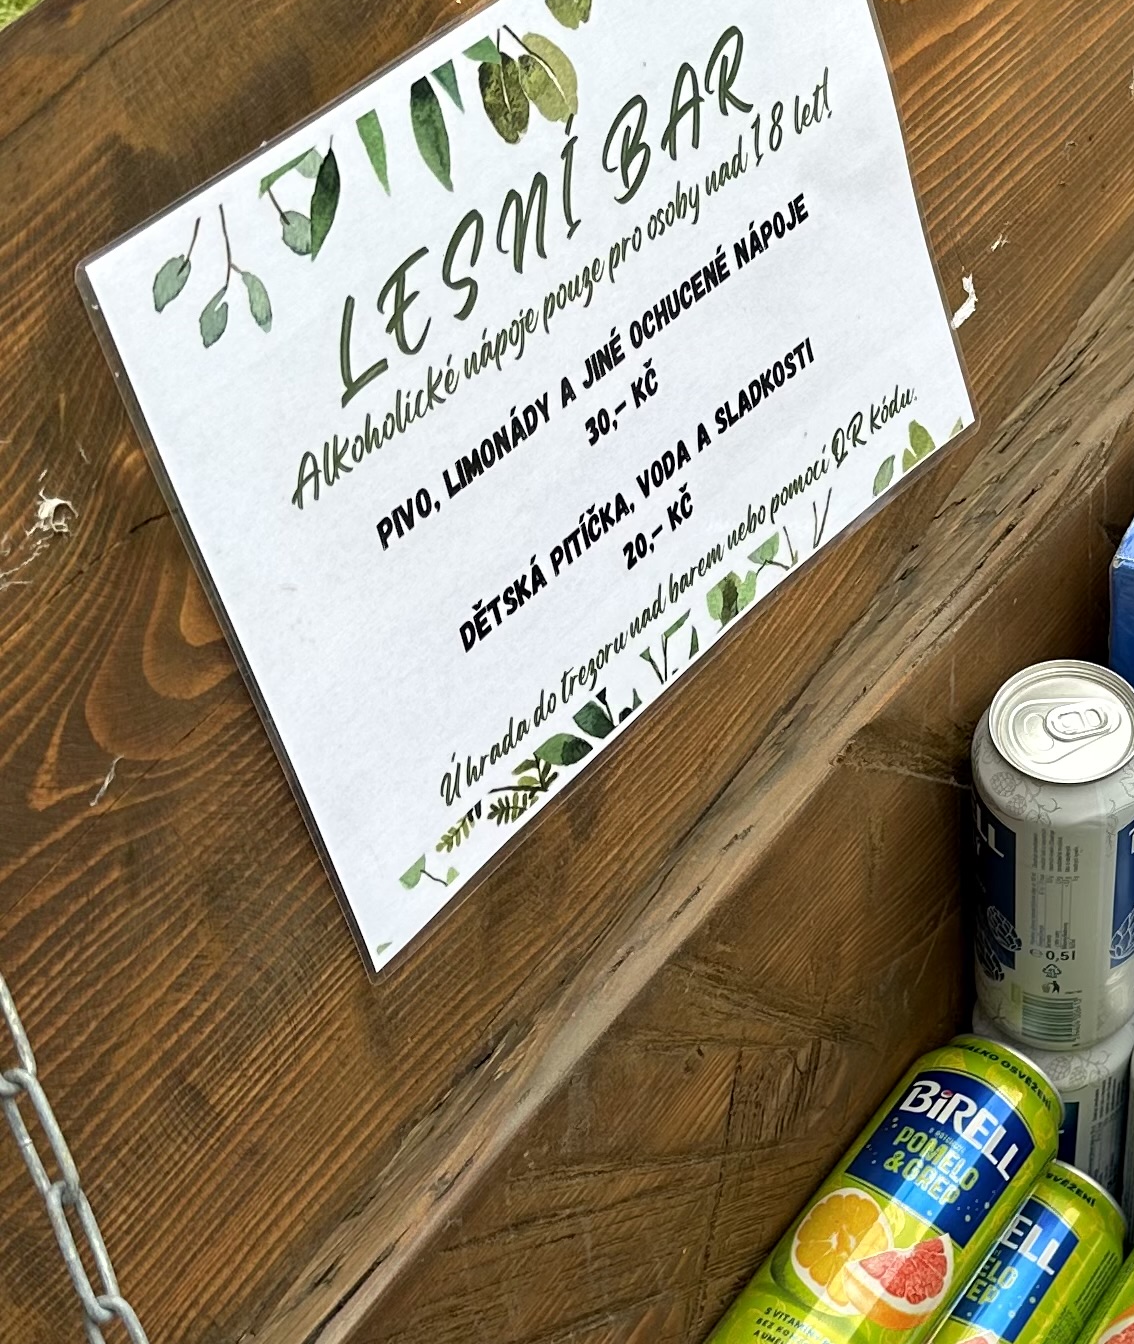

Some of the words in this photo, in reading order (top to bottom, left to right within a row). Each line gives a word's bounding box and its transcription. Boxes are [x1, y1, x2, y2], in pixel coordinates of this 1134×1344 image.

[339, 113, 582, 408] LESNÍ
[602, 25, 754, 204] BAR
[291, 353, 460, 511] Alkoholické
[464, 306, 540, 371] nápoje
[543, 257, 605, 334] pouze
[609, 226, 642, 283] pro
[647, 180, 700, 241] osoby
[706, 134, 748, 196] nad
[751, 100, 783, 167] 18
[795, 66, 832, 134] let!
[376, 488, 441, 551] PIVO,
[442, 392, 551, 499] LIMONÁDY
[560, 376, 577, 408] A
[583, 326, 625, 389] JINÉ
[629, 244, 731, 349] OCHUCENÉ
[733, 192, 809, 270] NÁPOJE
[631, 358, 659, 408] KČ
[459, 554, 548, 652] DĚTSKÁ
[550, 492, 636, 577] PITÍČKA,
[636, 439, 692, 498] VODA
[698, 422, 712, 453] A
[715, 337, 815, 434] SLADKOSTI
[667, 482, 694, 531] KČ
[440, 716, 530, 807] Úhrada
[534, 688, 557, 728] do
[561, 628, 628, 703] trezoru
[630, 583, 667, 638] nad
[669, 543, 725, 603] barem
[727, 503, 766, 551] nebo
[771, 444, 830, 524] pomocí
[832, 411, 867, 468] QR
[892, 1125, 980, 1191] POMELO
[899, 1080, 1018, 1182] BiRELL
[902, 1154, 961, 1205] GREP
[1001, 1215, 1060, 1276] ELL
[755, 1317, 773, 1329] BEZ
[966, 1284, 999, 1305] EP
